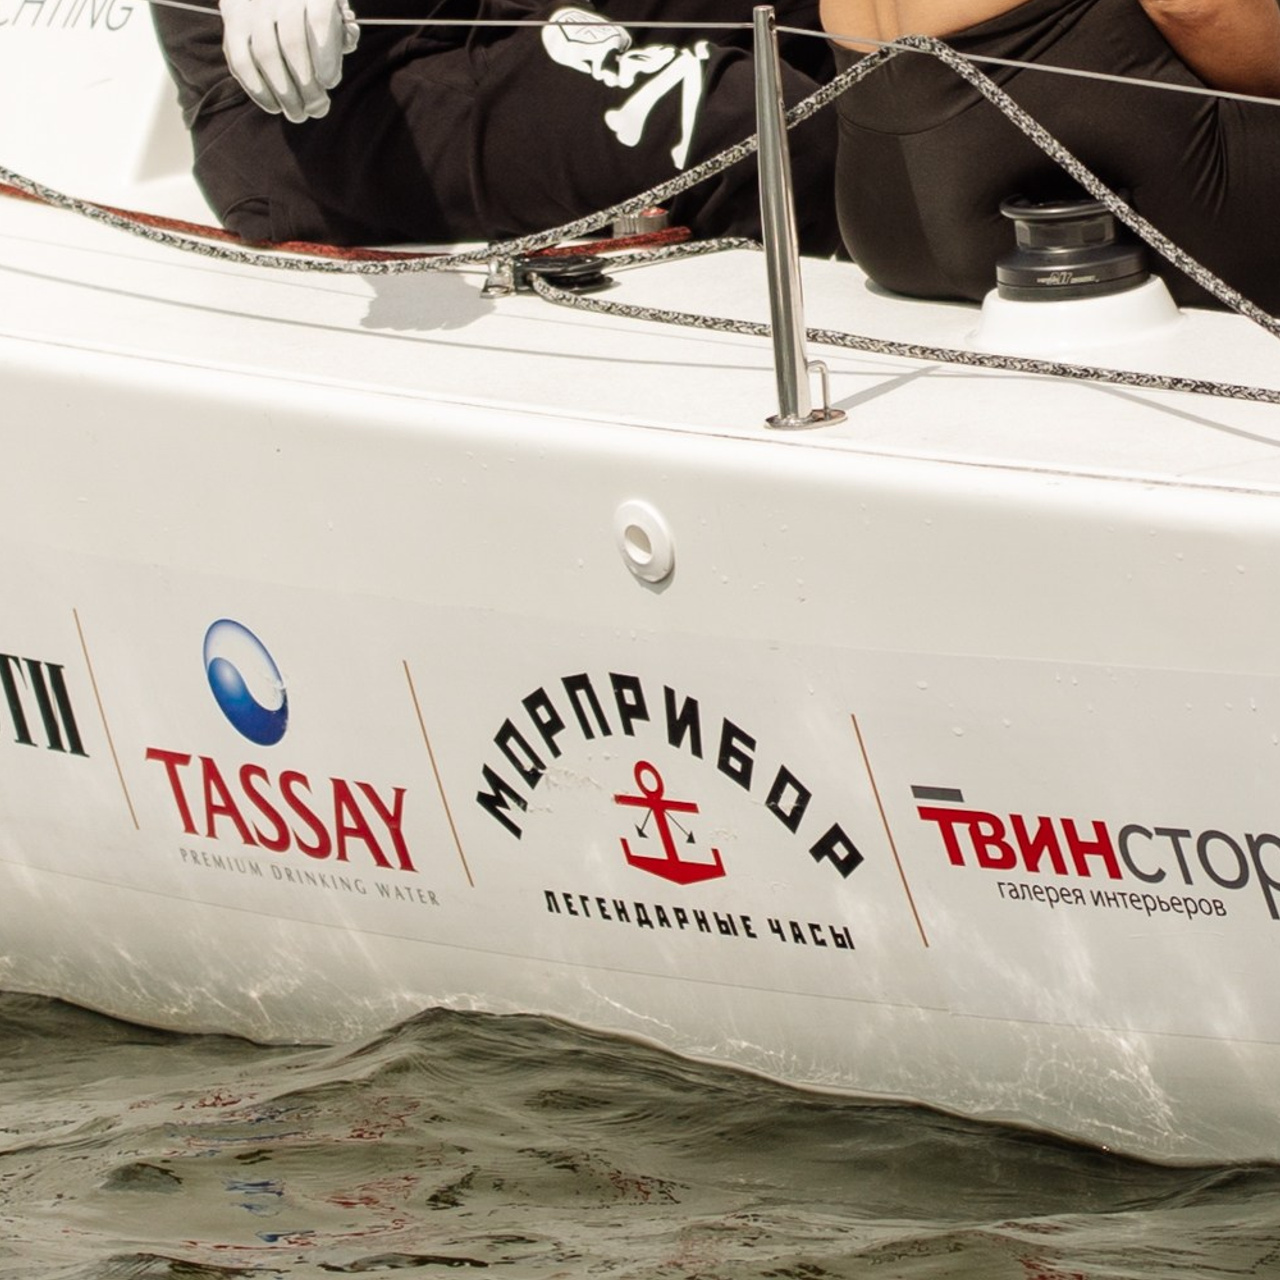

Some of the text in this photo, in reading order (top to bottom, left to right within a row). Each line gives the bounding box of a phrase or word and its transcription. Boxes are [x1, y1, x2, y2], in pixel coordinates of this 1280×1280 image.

[475, 672, 865, 880] МОРПРИБОР
[145, 747, 419, 873] TASSAY
[179, 847, 441, 907] PREMIUM DRINKING WATER
[997, 881, 1228, 920] галерея интерьеров
[543, 889, 856, 950] ЛЕГЕНДАРНЫЕ ЧАСЫ
